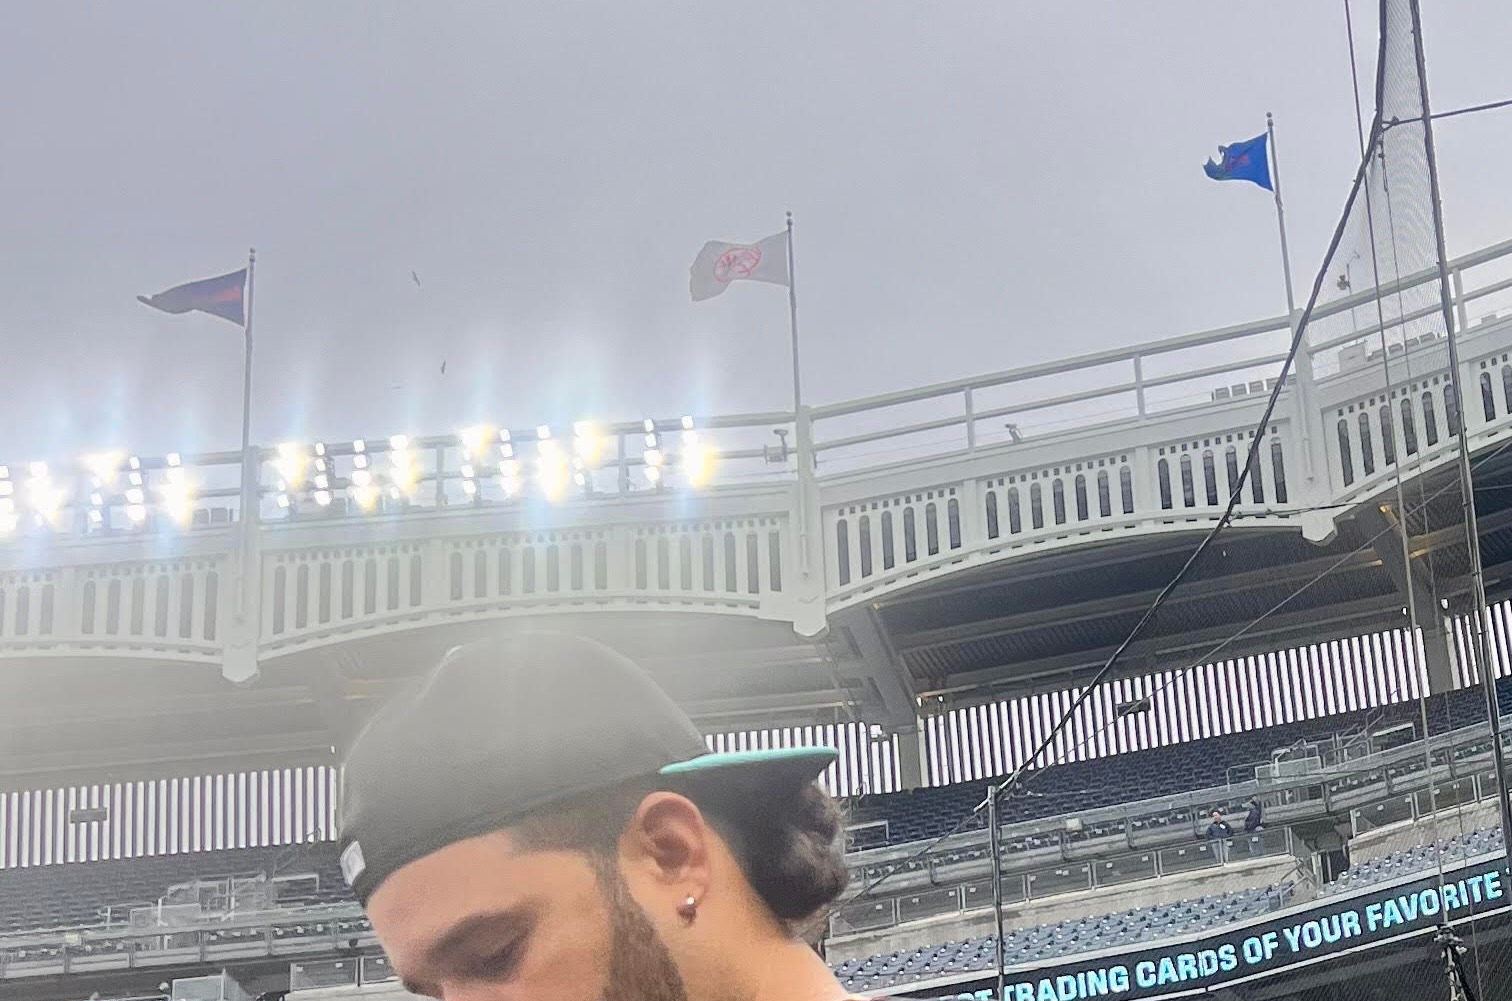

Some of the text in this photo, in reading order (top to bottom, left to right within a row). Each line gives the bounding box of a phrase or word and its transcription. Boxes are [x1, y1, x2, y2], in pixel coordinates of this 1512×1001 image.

[1136, 944, 1238, 989] CARDS
[1243, 931, 1279, 964] OF
[1283, 911, 1362, 949] YOUR
[1366, 870, 1503, 933] FAVORITE
